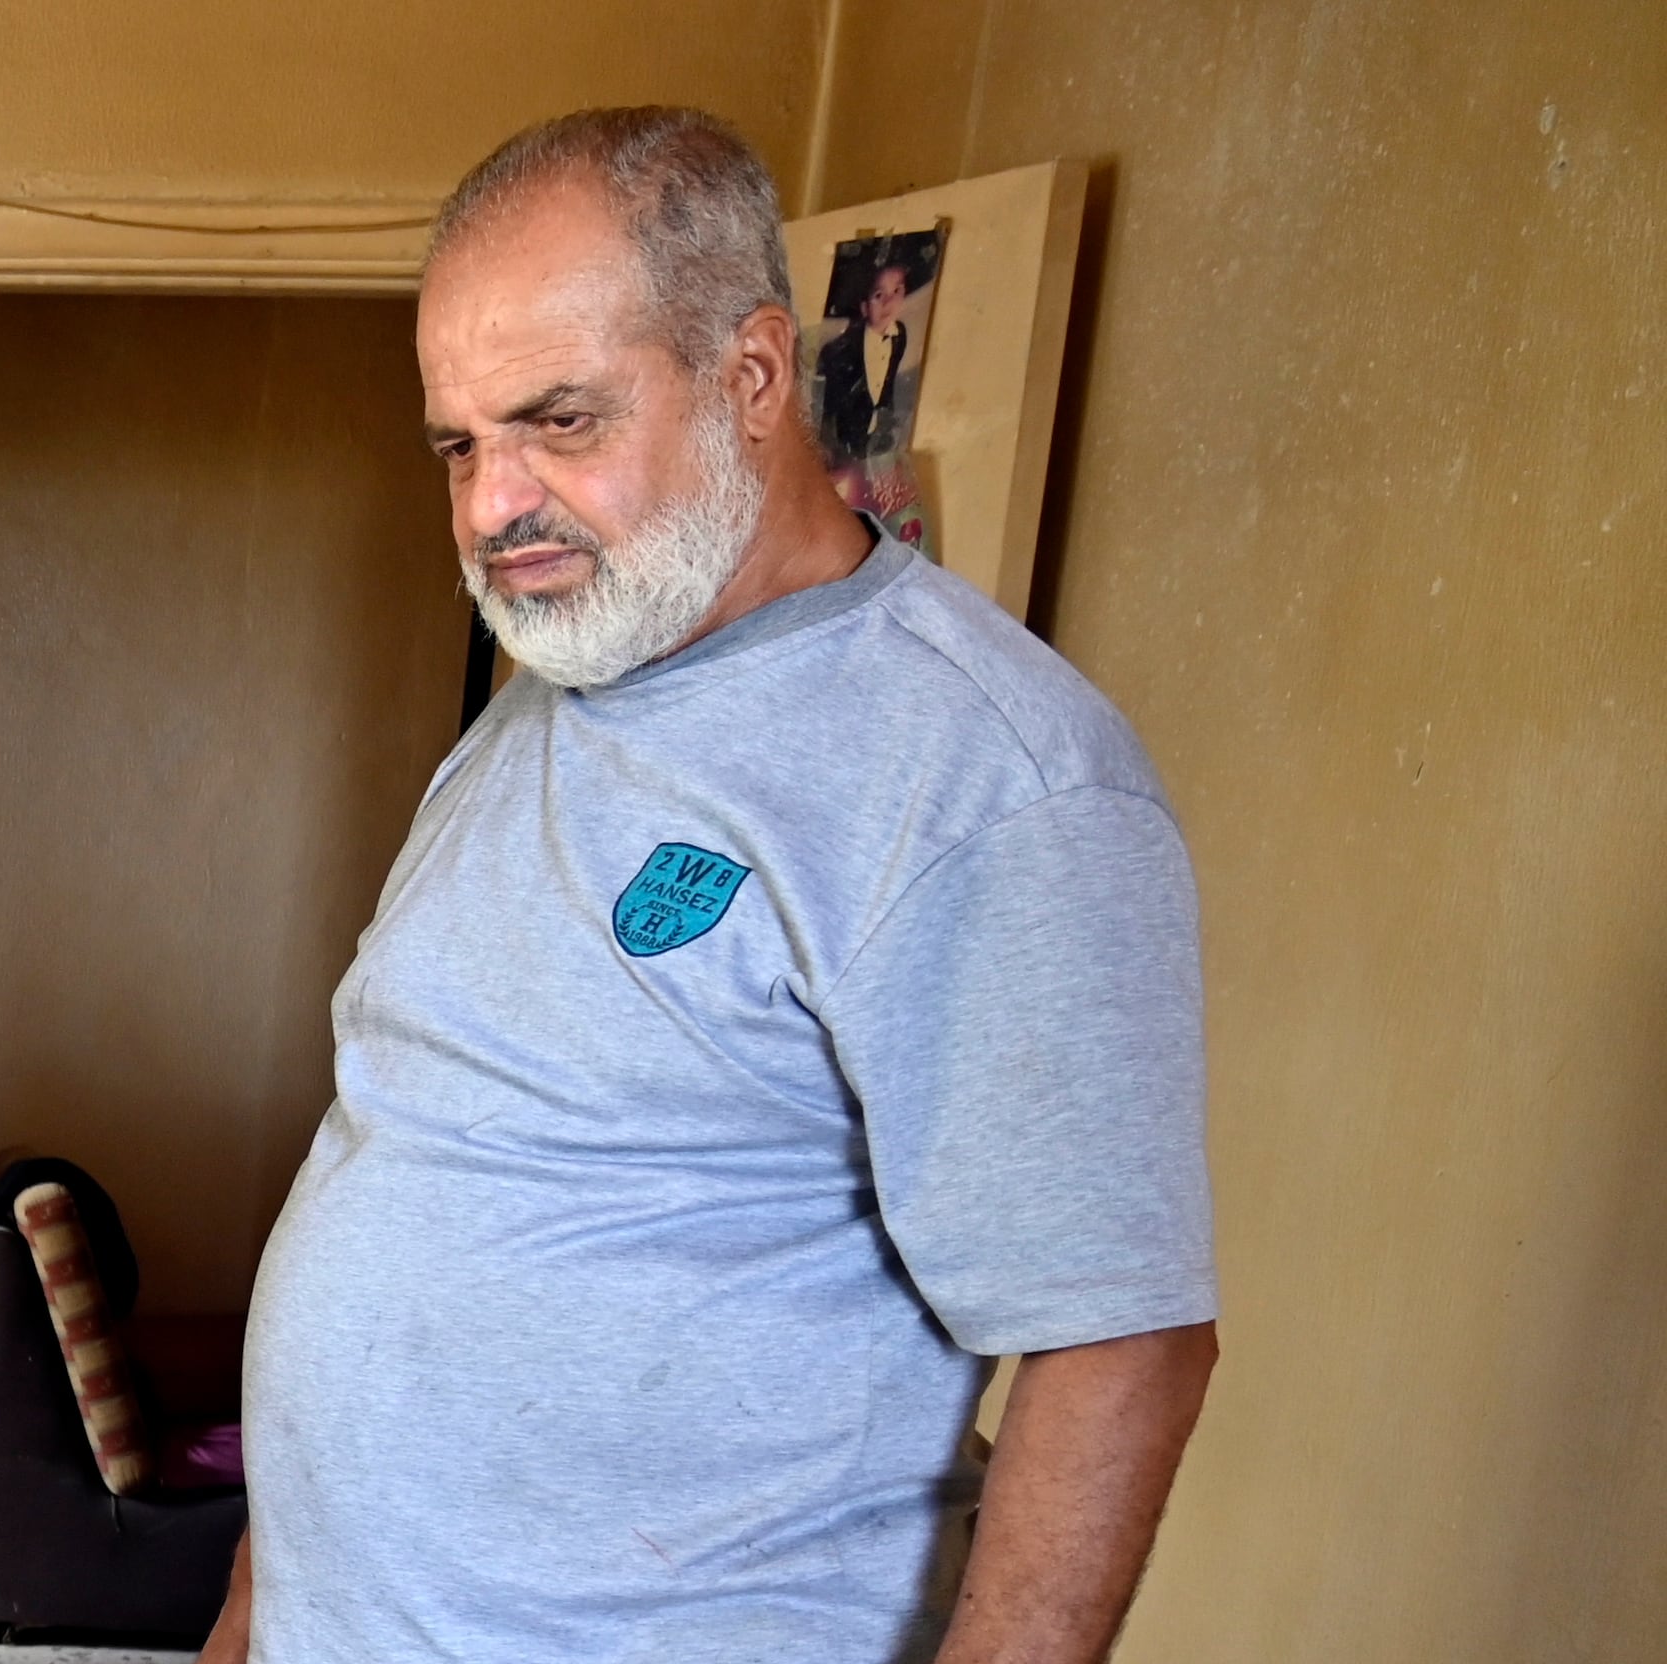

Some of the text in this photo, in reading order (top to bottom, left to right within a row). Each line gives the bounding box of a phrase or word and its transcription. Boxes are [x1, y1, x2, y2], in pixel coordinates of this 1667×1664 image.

[655, 851, 734, 888] 2 W 8
[636, 876, 719, 914] HANSEZ
[640, 912, 668, 935] H
